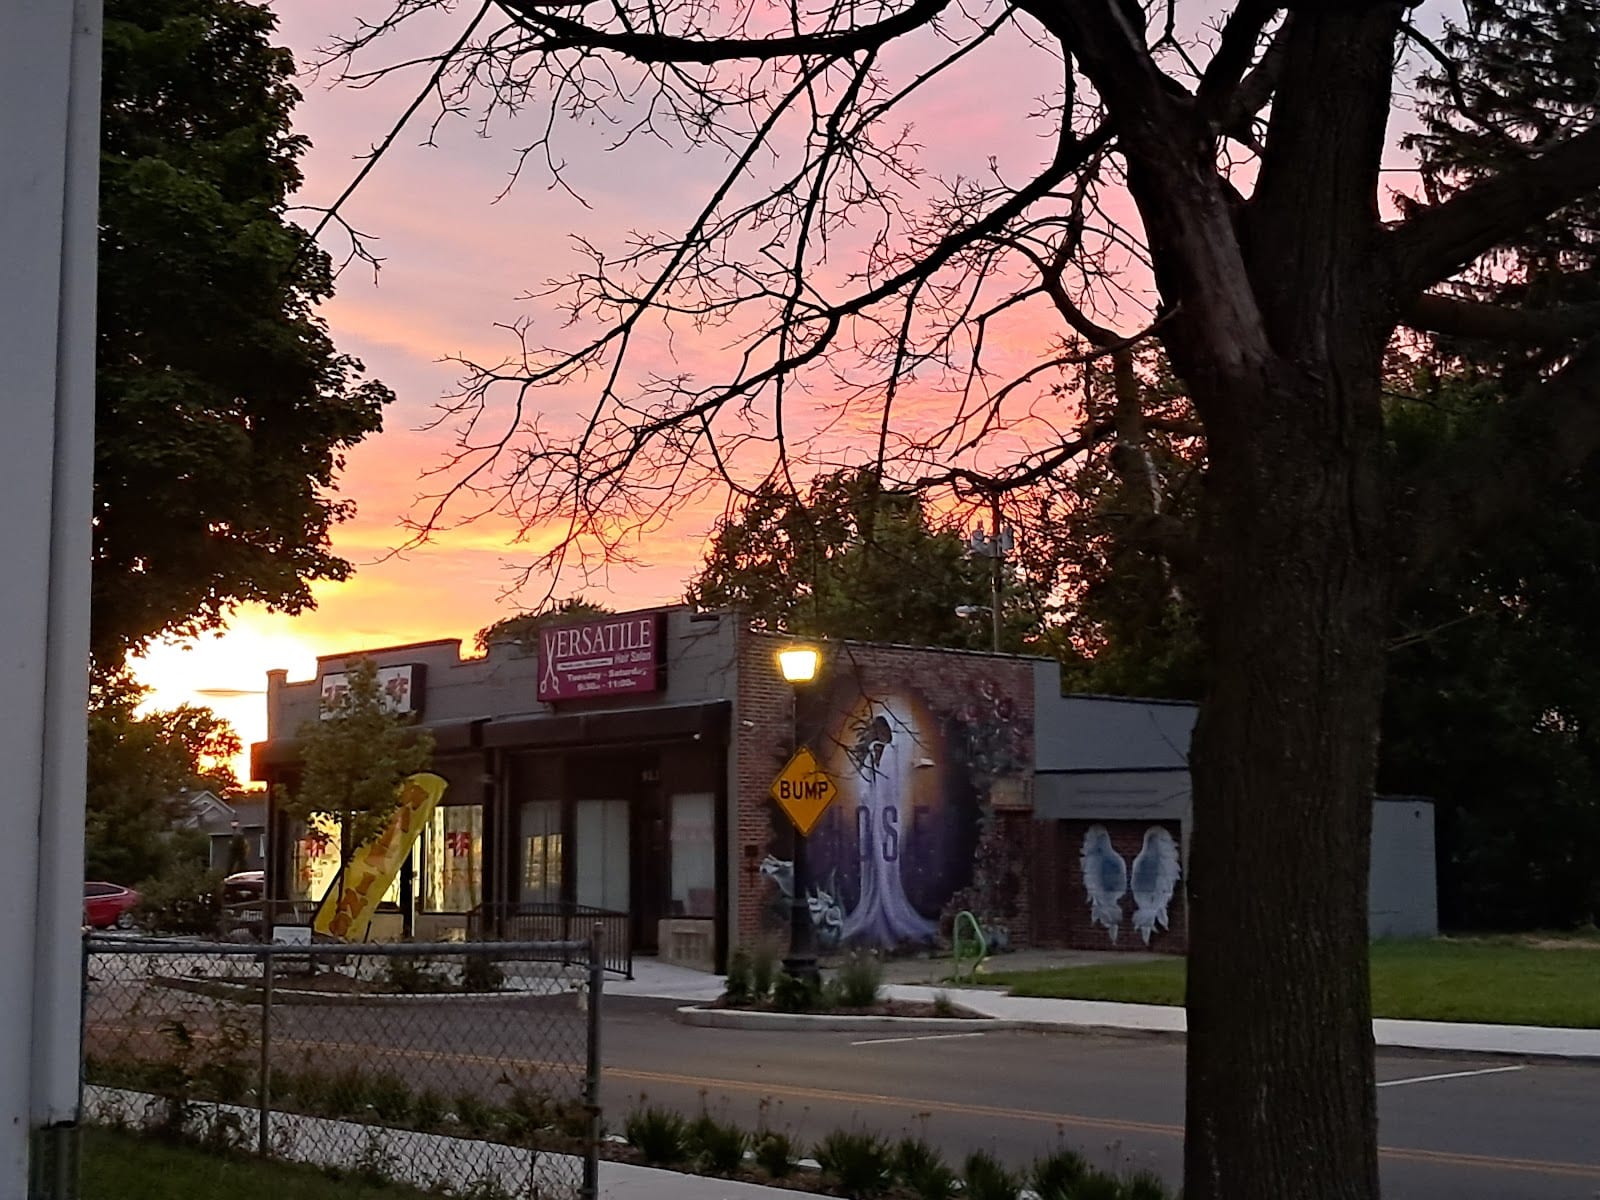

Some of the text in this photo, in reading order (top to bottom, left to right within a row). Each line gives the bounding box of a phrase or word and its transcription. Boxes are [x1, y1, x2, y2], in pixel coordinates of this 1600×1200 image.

[544, 619, 652, 661] VERSATILE
[567, 672, 601, 682] Tuesday
[780, 781, 828, 800] BUMP
